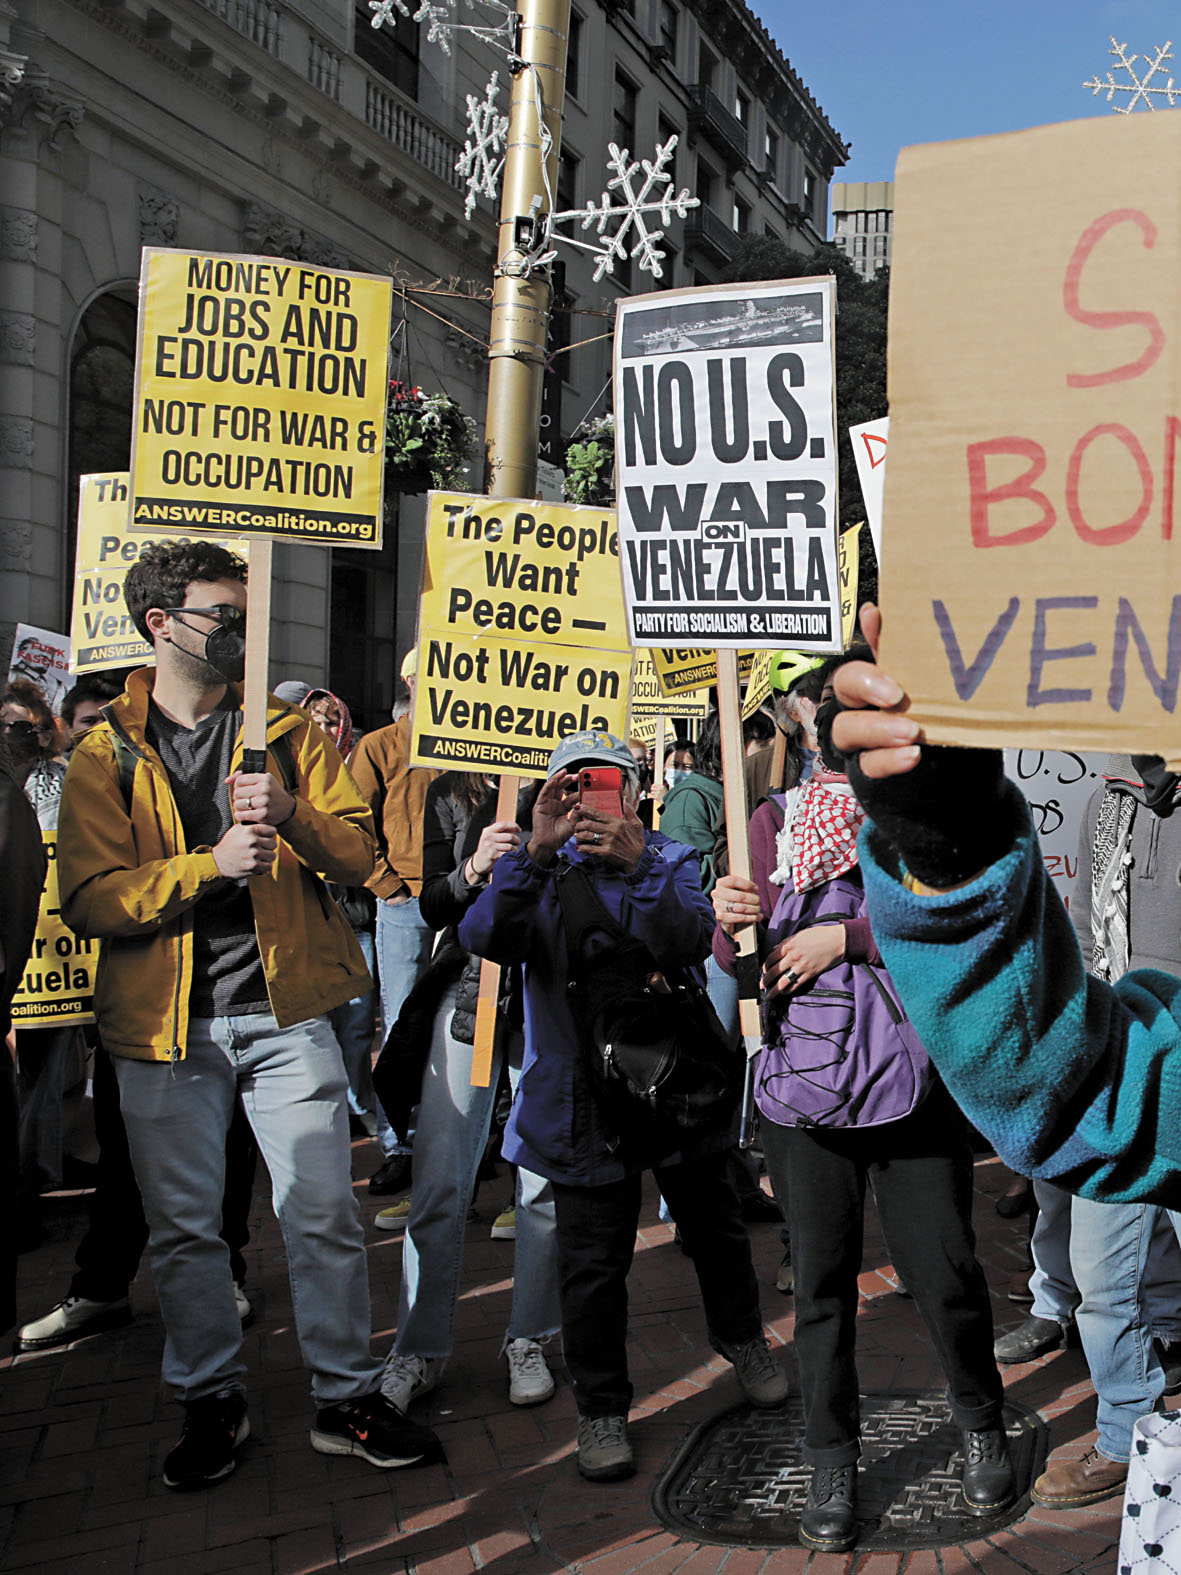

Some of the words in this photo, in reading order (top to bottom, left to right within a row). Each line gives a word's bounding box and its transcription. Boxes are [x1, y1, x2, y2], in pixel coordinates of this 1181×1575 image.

[188, 258, 291, 297] MONEY
[298, 270, 351, 308] FOR
[178, 294, 271, 341] JOBS
[280, 304, 358, 353] AND
[155, 335, 366, 398] EDUCATION
[143, 398, 206, 437] NOT
[213, 404, 271, 443] FOR
[280, 410, 349, 451] WAR
[357, 420, 377, 454] &
[623, 360, 697, 467] NO
[707, 352, 825, 464] U.S.
[95, 478, 127, 502] Th
[162, 449, 353, 500] OCCUPATION
[135, 504, 373, 539] ANSWERCoalition.org
[624, 479, 826, 532] WAR
[443, 504, 504, 543] The
[513, 512, 619, 562] People
[704, 524, 740, 540] ON
[82, 577, 121, 606] No
[484, 550, 580, 596] Want
[626, 536, 831, 602] VENEZUELA
[83, 610, 135, 640] Ven
[448, 587, 562, 635] Peace
[636, 612, 666, 633] PARTY
[667, 612, 688, 633] FOR
[689, 612, 747, 633] SOCIALISM
[750, 613, 766, 633] &
[766, 613, 827, 635] LIBERATION
[31, 641, 65, 658] FUCK
[90, 642, 153, 661] ANSWERC
[427, 639, 490, 684] Not
[500, 648, 569, 693] War
[576, 666, 620, 700] on
[428, 687, 609, 740] Venezuela
[632, 705, 704, 716] SWERCoalition.org
[433, 739, 550, 767] ANSWERCoaliti
[11, 1001, 82, 1016] oalition.org
